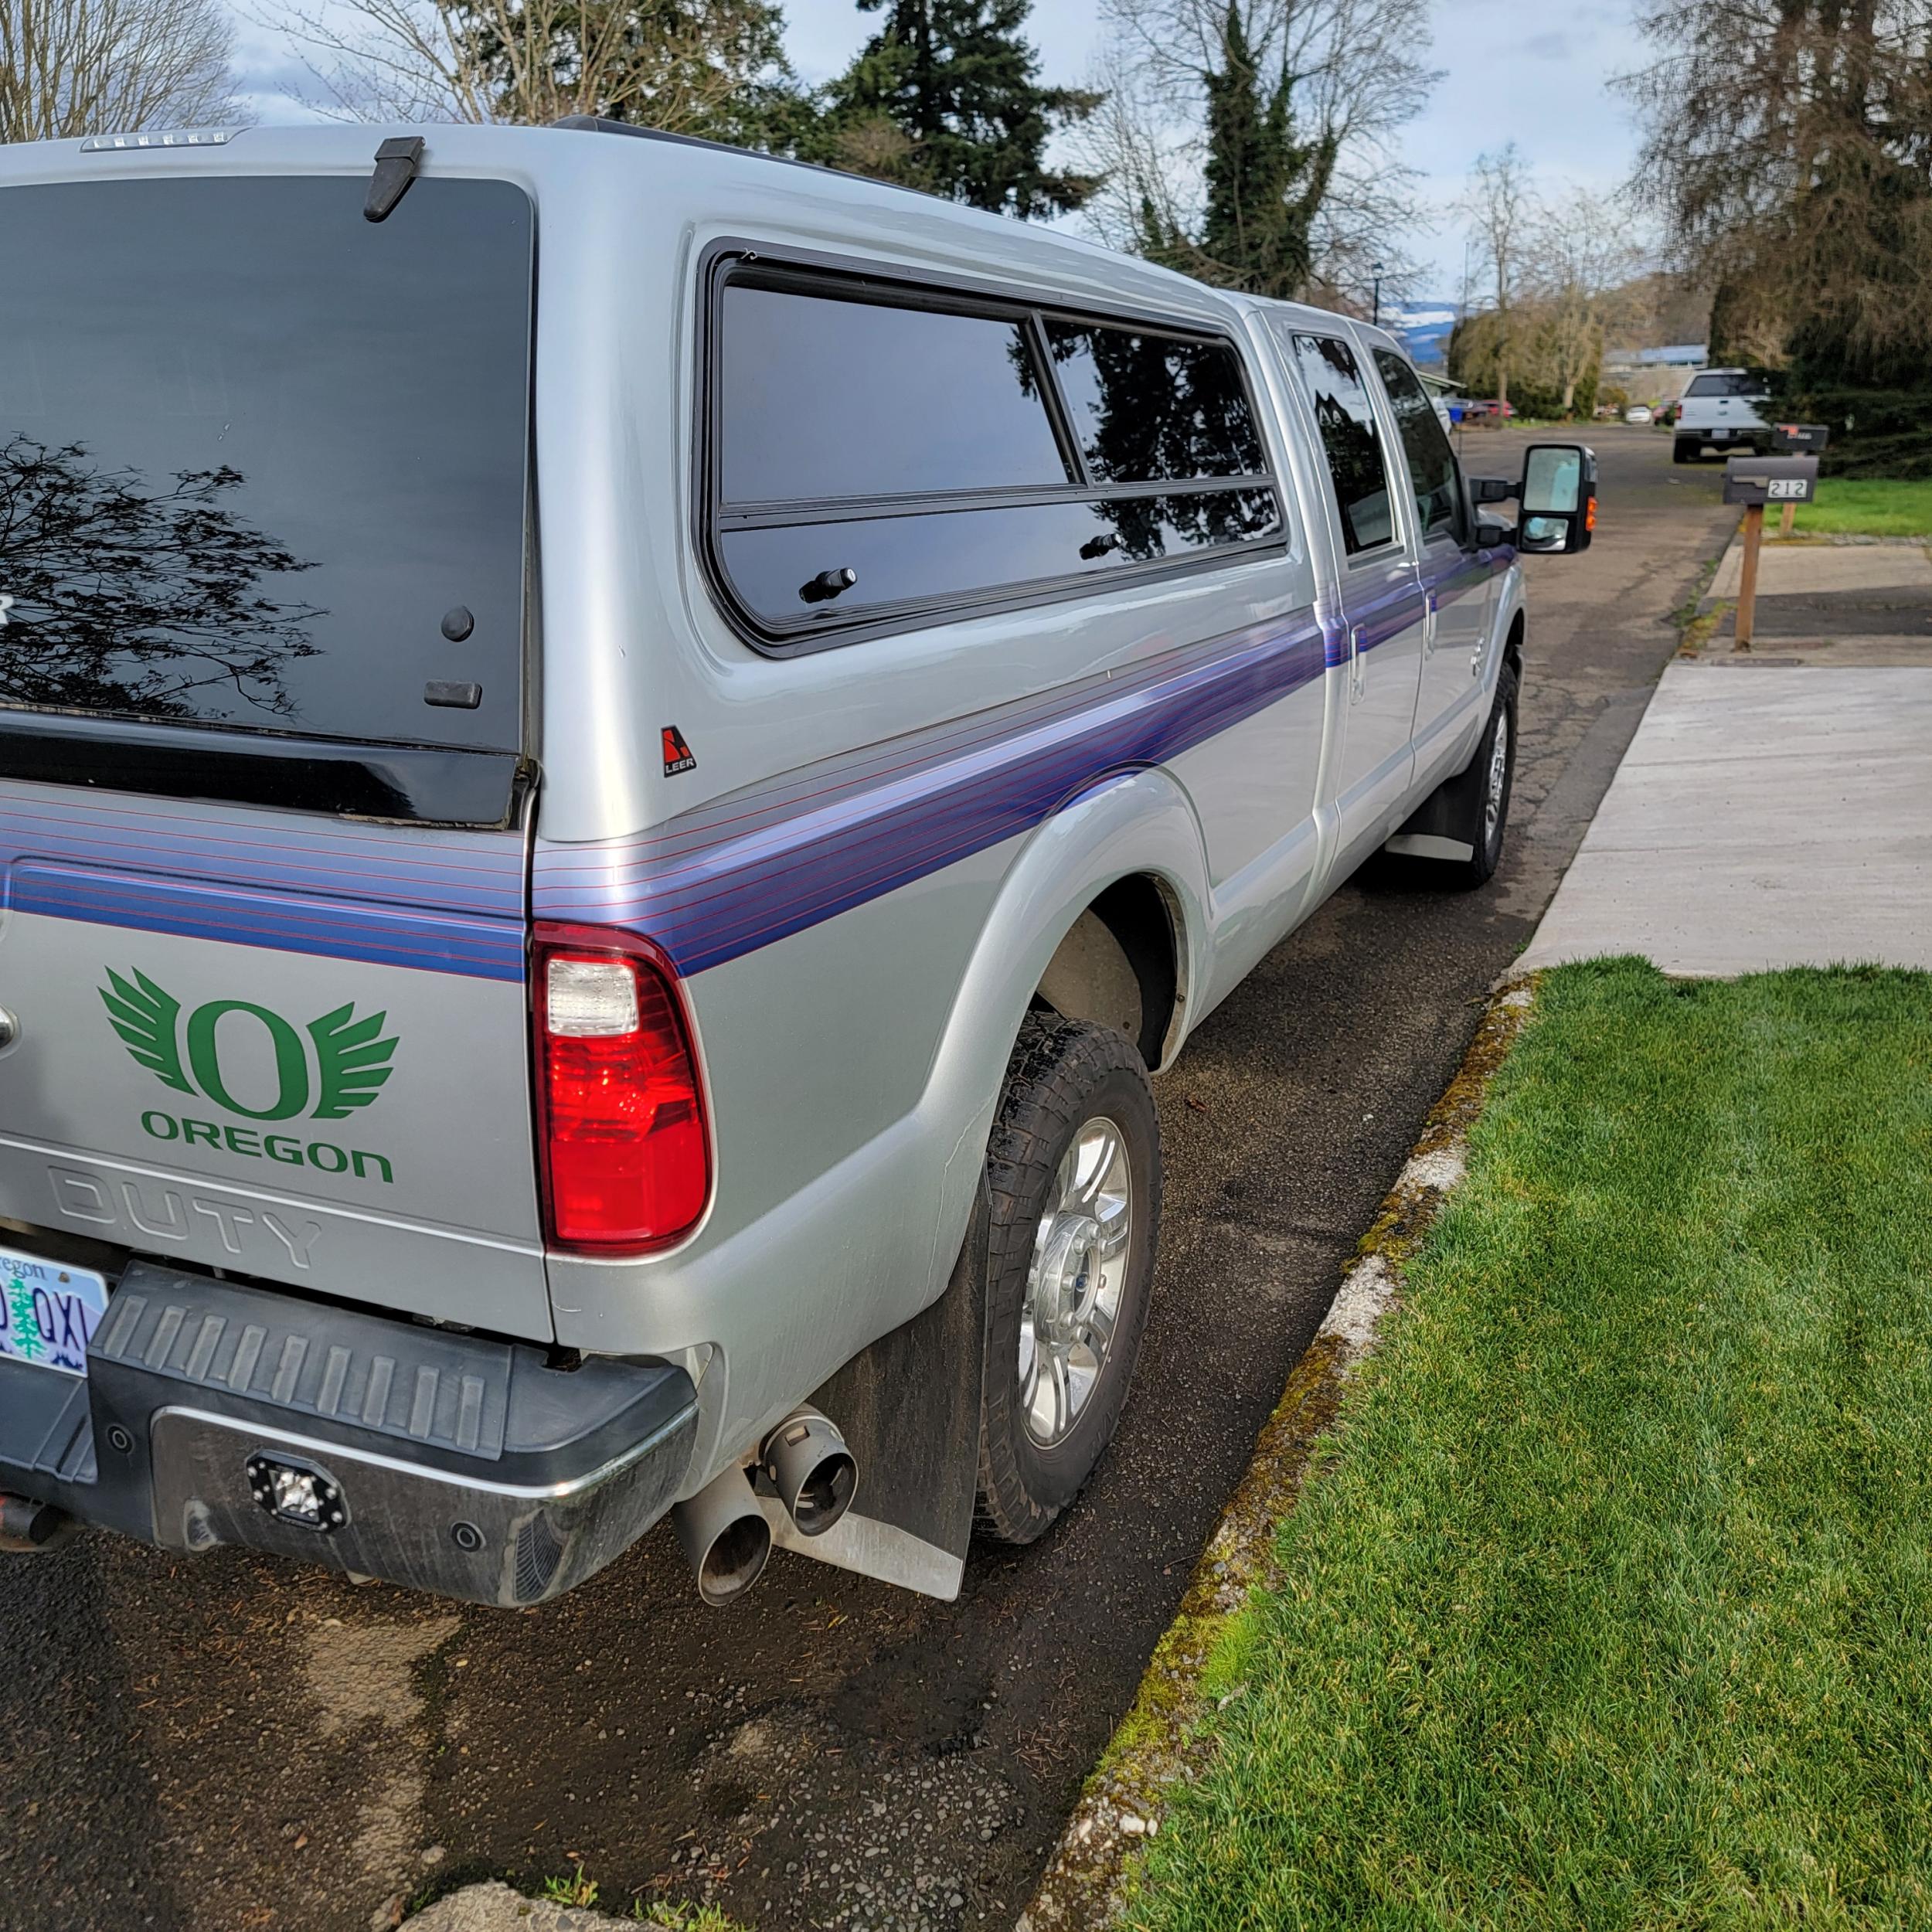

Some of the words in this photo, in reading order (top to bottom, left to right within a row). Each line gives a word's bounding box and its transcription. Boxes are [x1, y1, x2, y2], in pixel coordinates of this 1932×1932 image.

[1770, 481, 1804, 496] 212
[665, 758, 695, 774] LEER
[141, 1111, 394, 1184] OREGON
[47, 1165, 322, 1270] DUTY
[0, 1257, 48, 1281] egon
